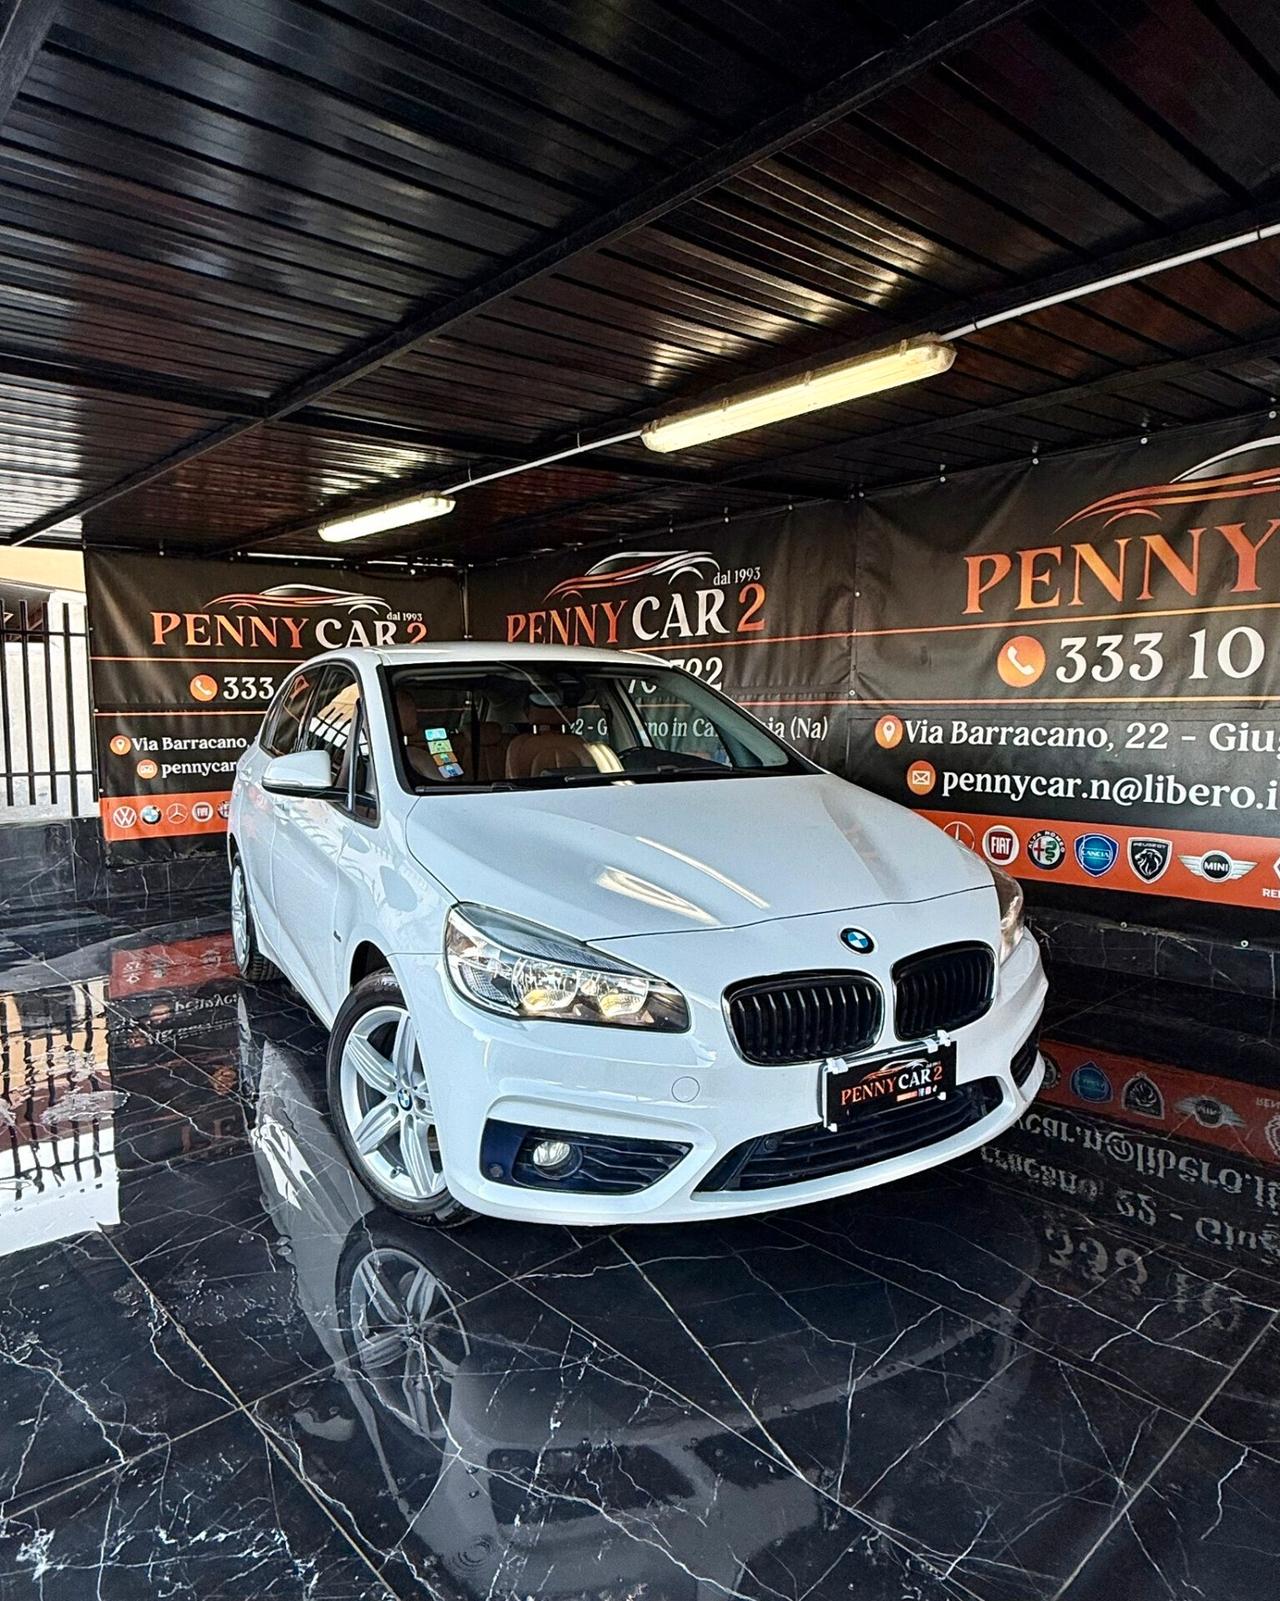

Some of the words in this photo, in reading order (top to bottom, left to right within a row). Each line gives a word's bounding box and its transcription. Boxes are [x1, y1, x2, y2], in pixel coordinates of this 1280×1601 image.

[713, 570, 731, 586] dal
[734, 566, 761, 584] 1993
[961, 518, 1280, 616] PENNY
[386, 611, 401, 621] dal
[402, 612, 423, 622] 1993
[506, 600, 628, 646] PENNY
[631, 588, 731, 641] CAR
[736, 582, 766, 632] 2
[150, 610, 310, 649] PENNY
[315, 618, 397, 649] CAR
[1055, 631, 1164, 684] 333
[1188, 625, 1266, 681] 10
[223, 676, 275, 700] 333
[790, 715, 828, 741] (Na)
[904, 720, 944, 745] Via
[950, 720, 1114, 752] Barracano,
[1125, 721, 1169, 750] 22
[1209, 721, 1280, 762] Giu
[131, 736, 159, 751] Via
[991, 836, 1012, 856] FIAT
[1203, 860, 1229, 872] MINI
[841, 1076, 897, 1106] PENNY
[898, 1069, 932, 1090] CAR
[933, 1065, 943, 1081] 2
